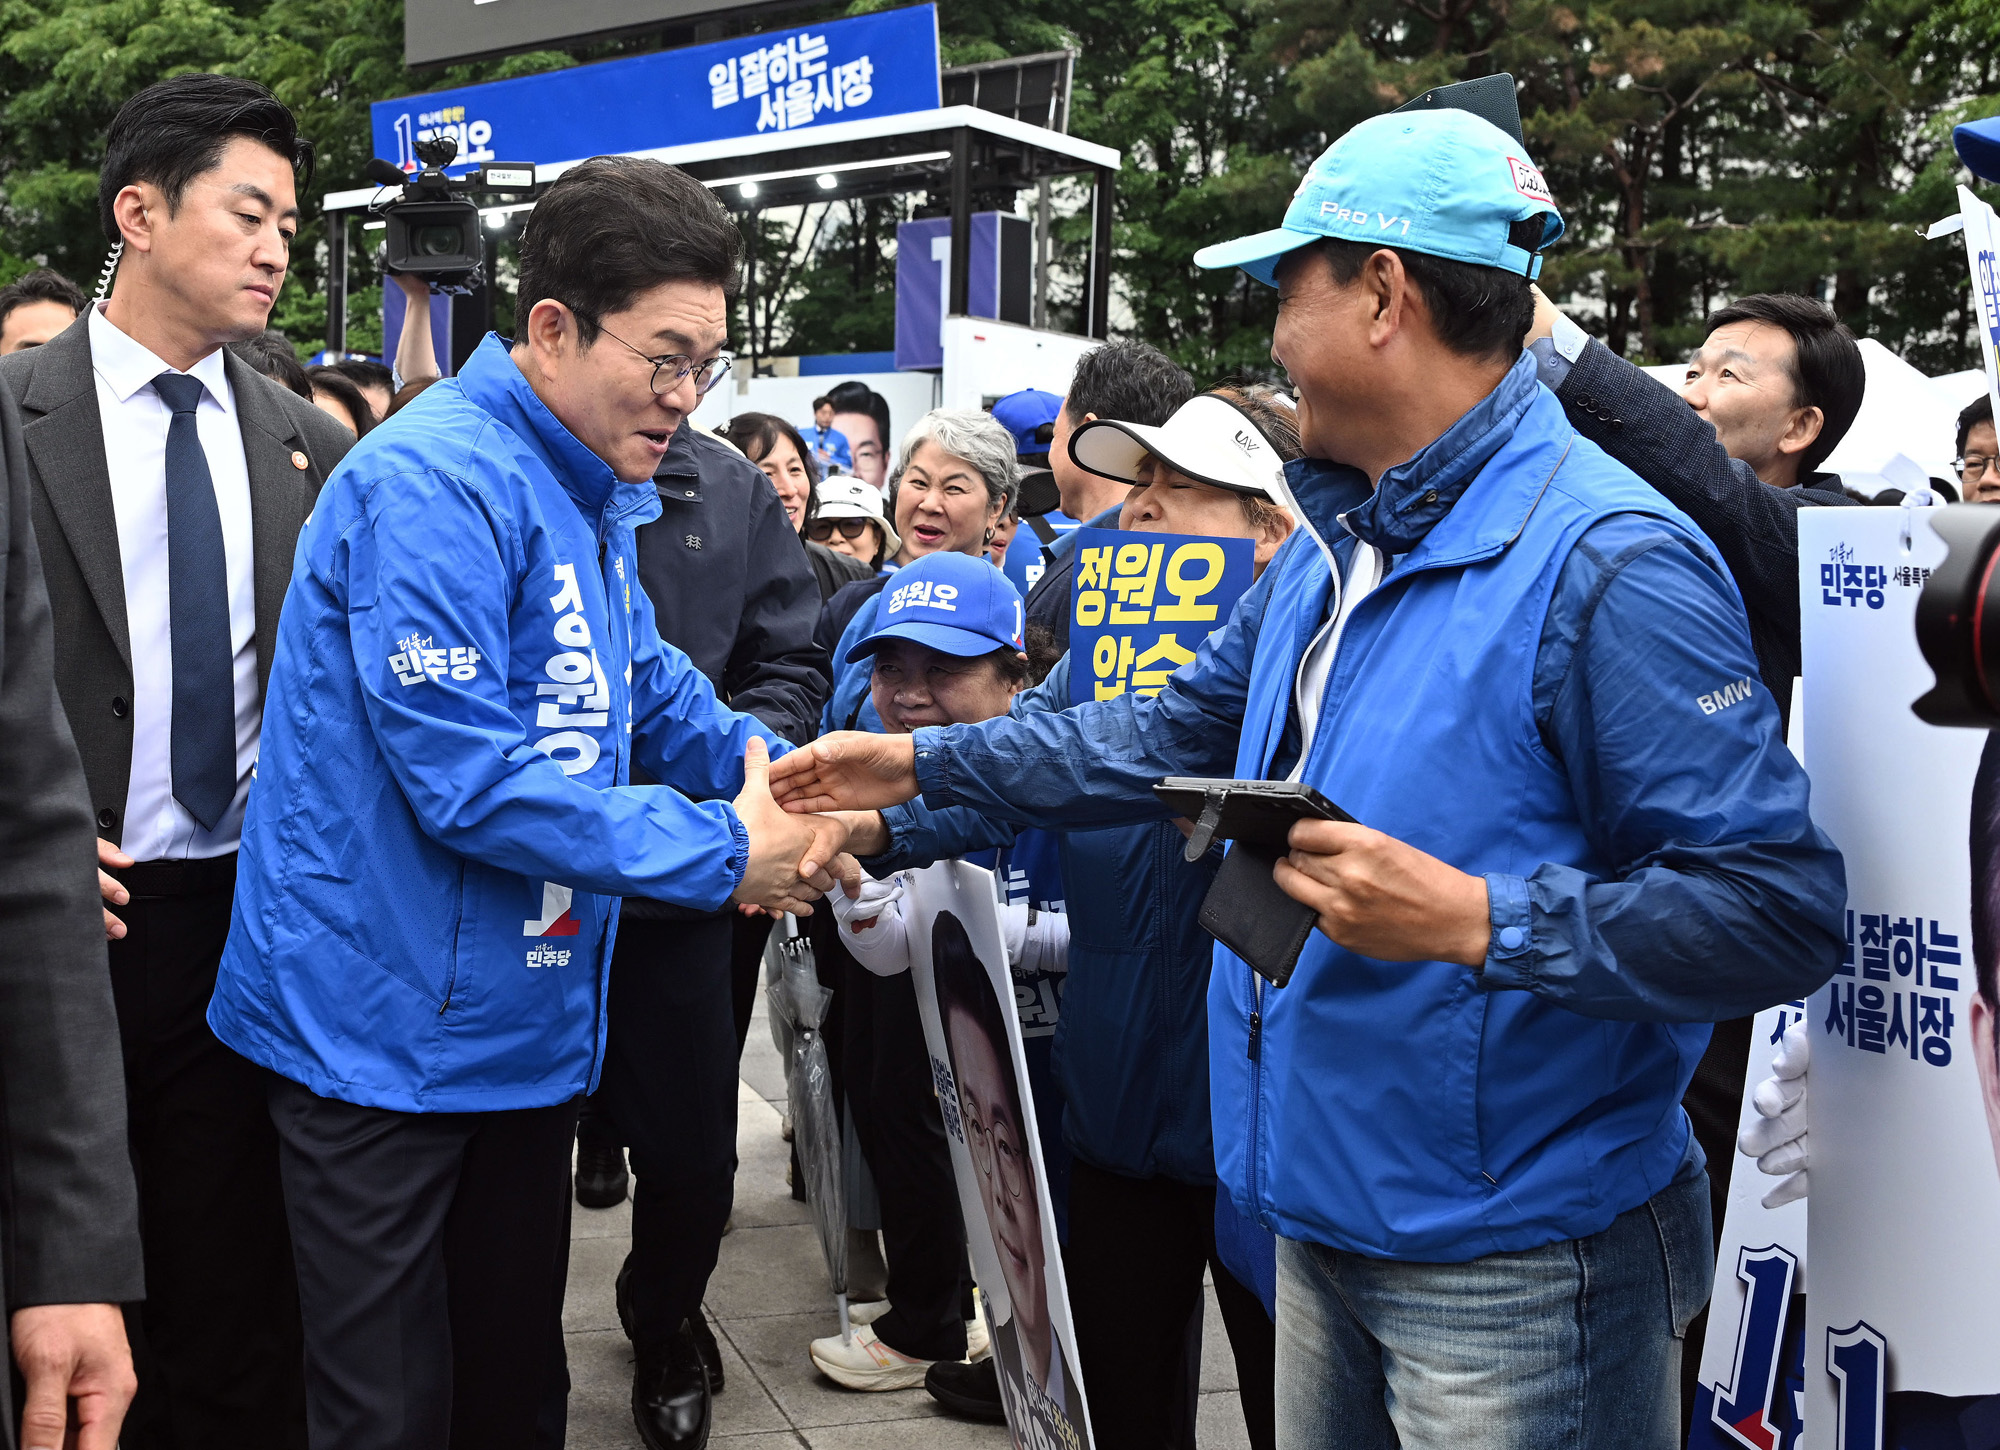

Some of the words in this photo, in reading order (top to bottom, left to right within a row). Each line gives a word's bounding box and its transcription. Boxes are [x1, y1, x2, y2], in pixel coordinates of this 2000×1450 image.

[756, 55, 874, 132] 서울시장
[1377, 212, 1412, 236] V1
[1829, 541, 1854, 567] 더불어
[888, 581, 959, 614] 정원오
[1076, 542, 1226, 626] 정원오
[1820, 563, 1887, 610] 민주당
[396, 631, 434, 654] 더불어
[387, 647, 481, 687] 민주당
[1696, 676, 1752, 715] BMW
[526, 949, 572, 968] 민주당
[1825, 981, 1955, 1068] 서울시장
[1711, 1242, 1799, 1450] 1
